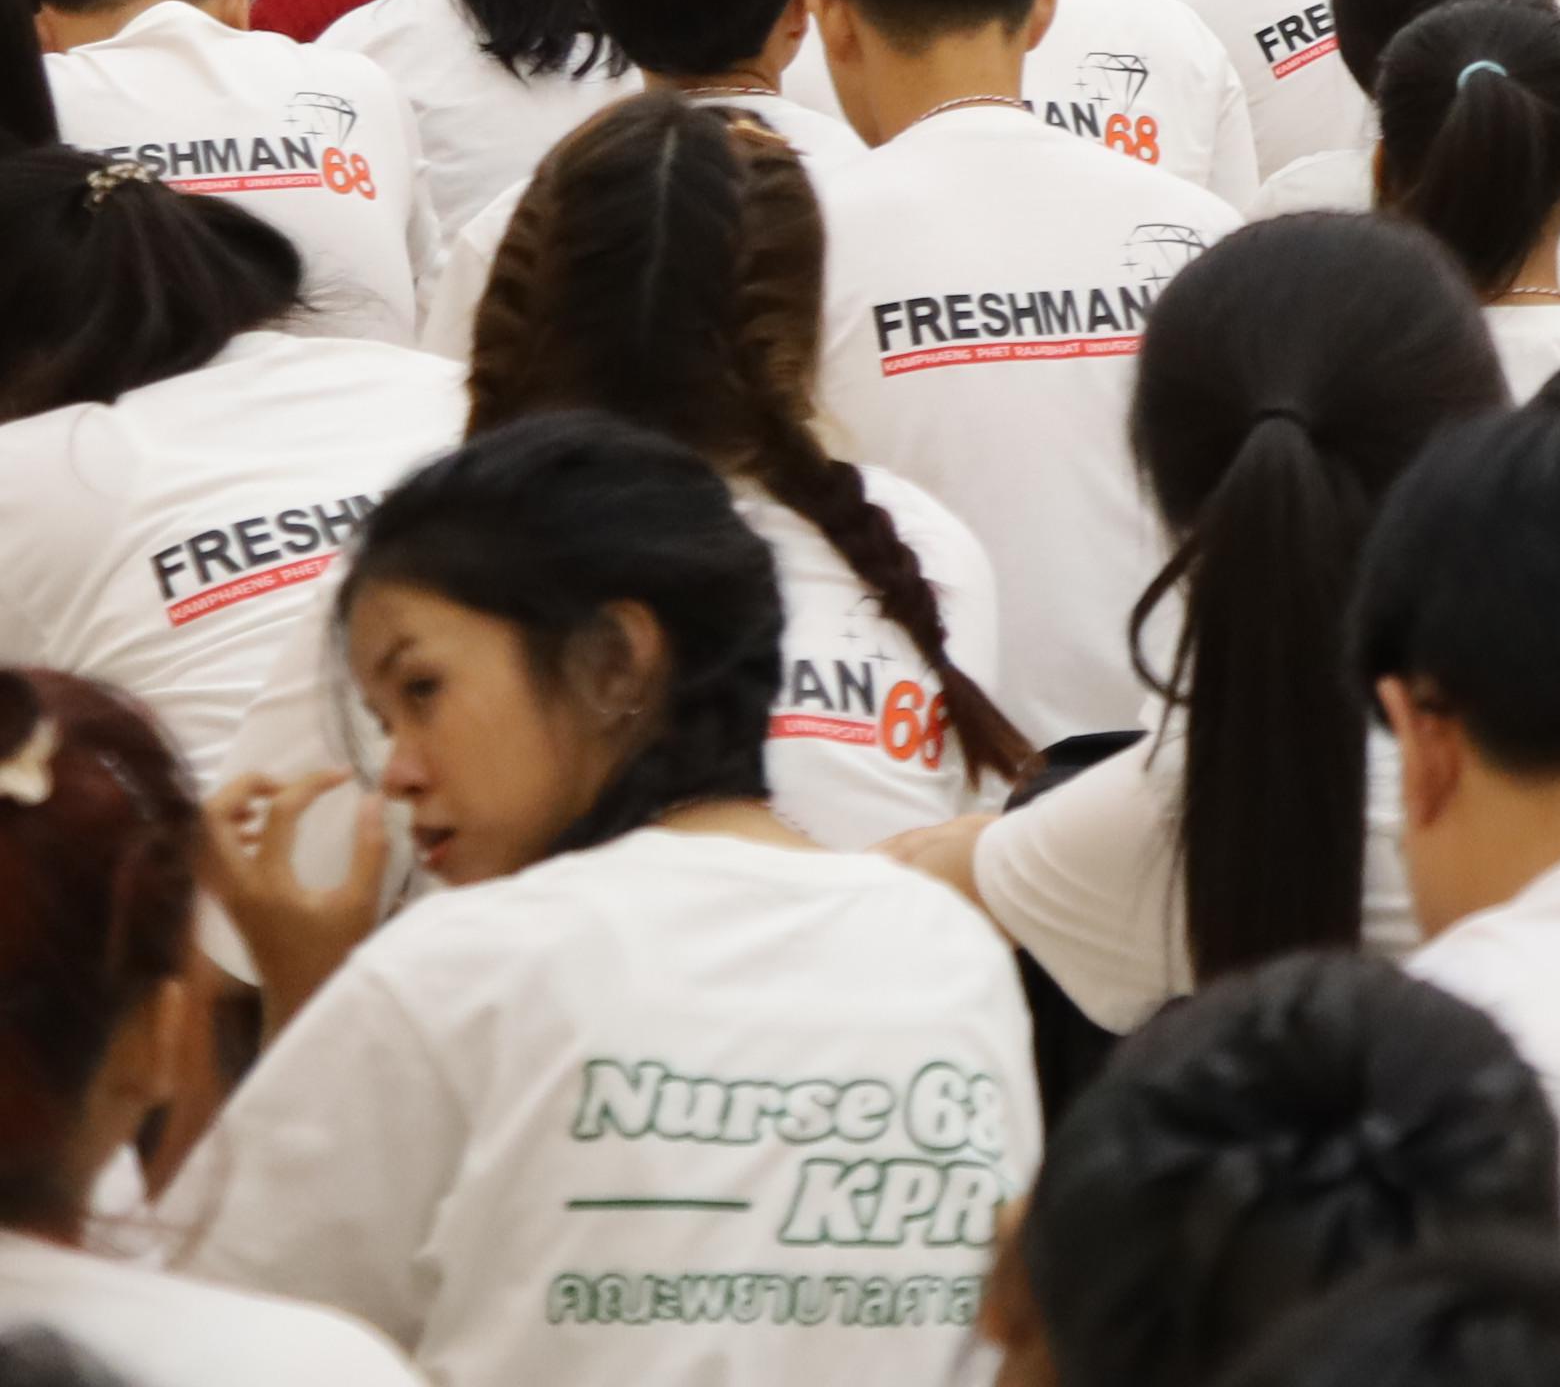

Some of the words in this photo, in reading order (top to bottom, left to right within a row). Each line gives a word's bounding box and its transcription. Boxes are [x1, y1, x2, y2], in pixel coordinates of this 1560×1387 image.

[1104, 113, 1160, 166] 68
[321, 146, 377, 201] 68
[872, 285, 1151, 352] FRESHMAN
[570, 1059, 894, 1144] Nurse
[776, 1157, 1004, 1247] KPR
